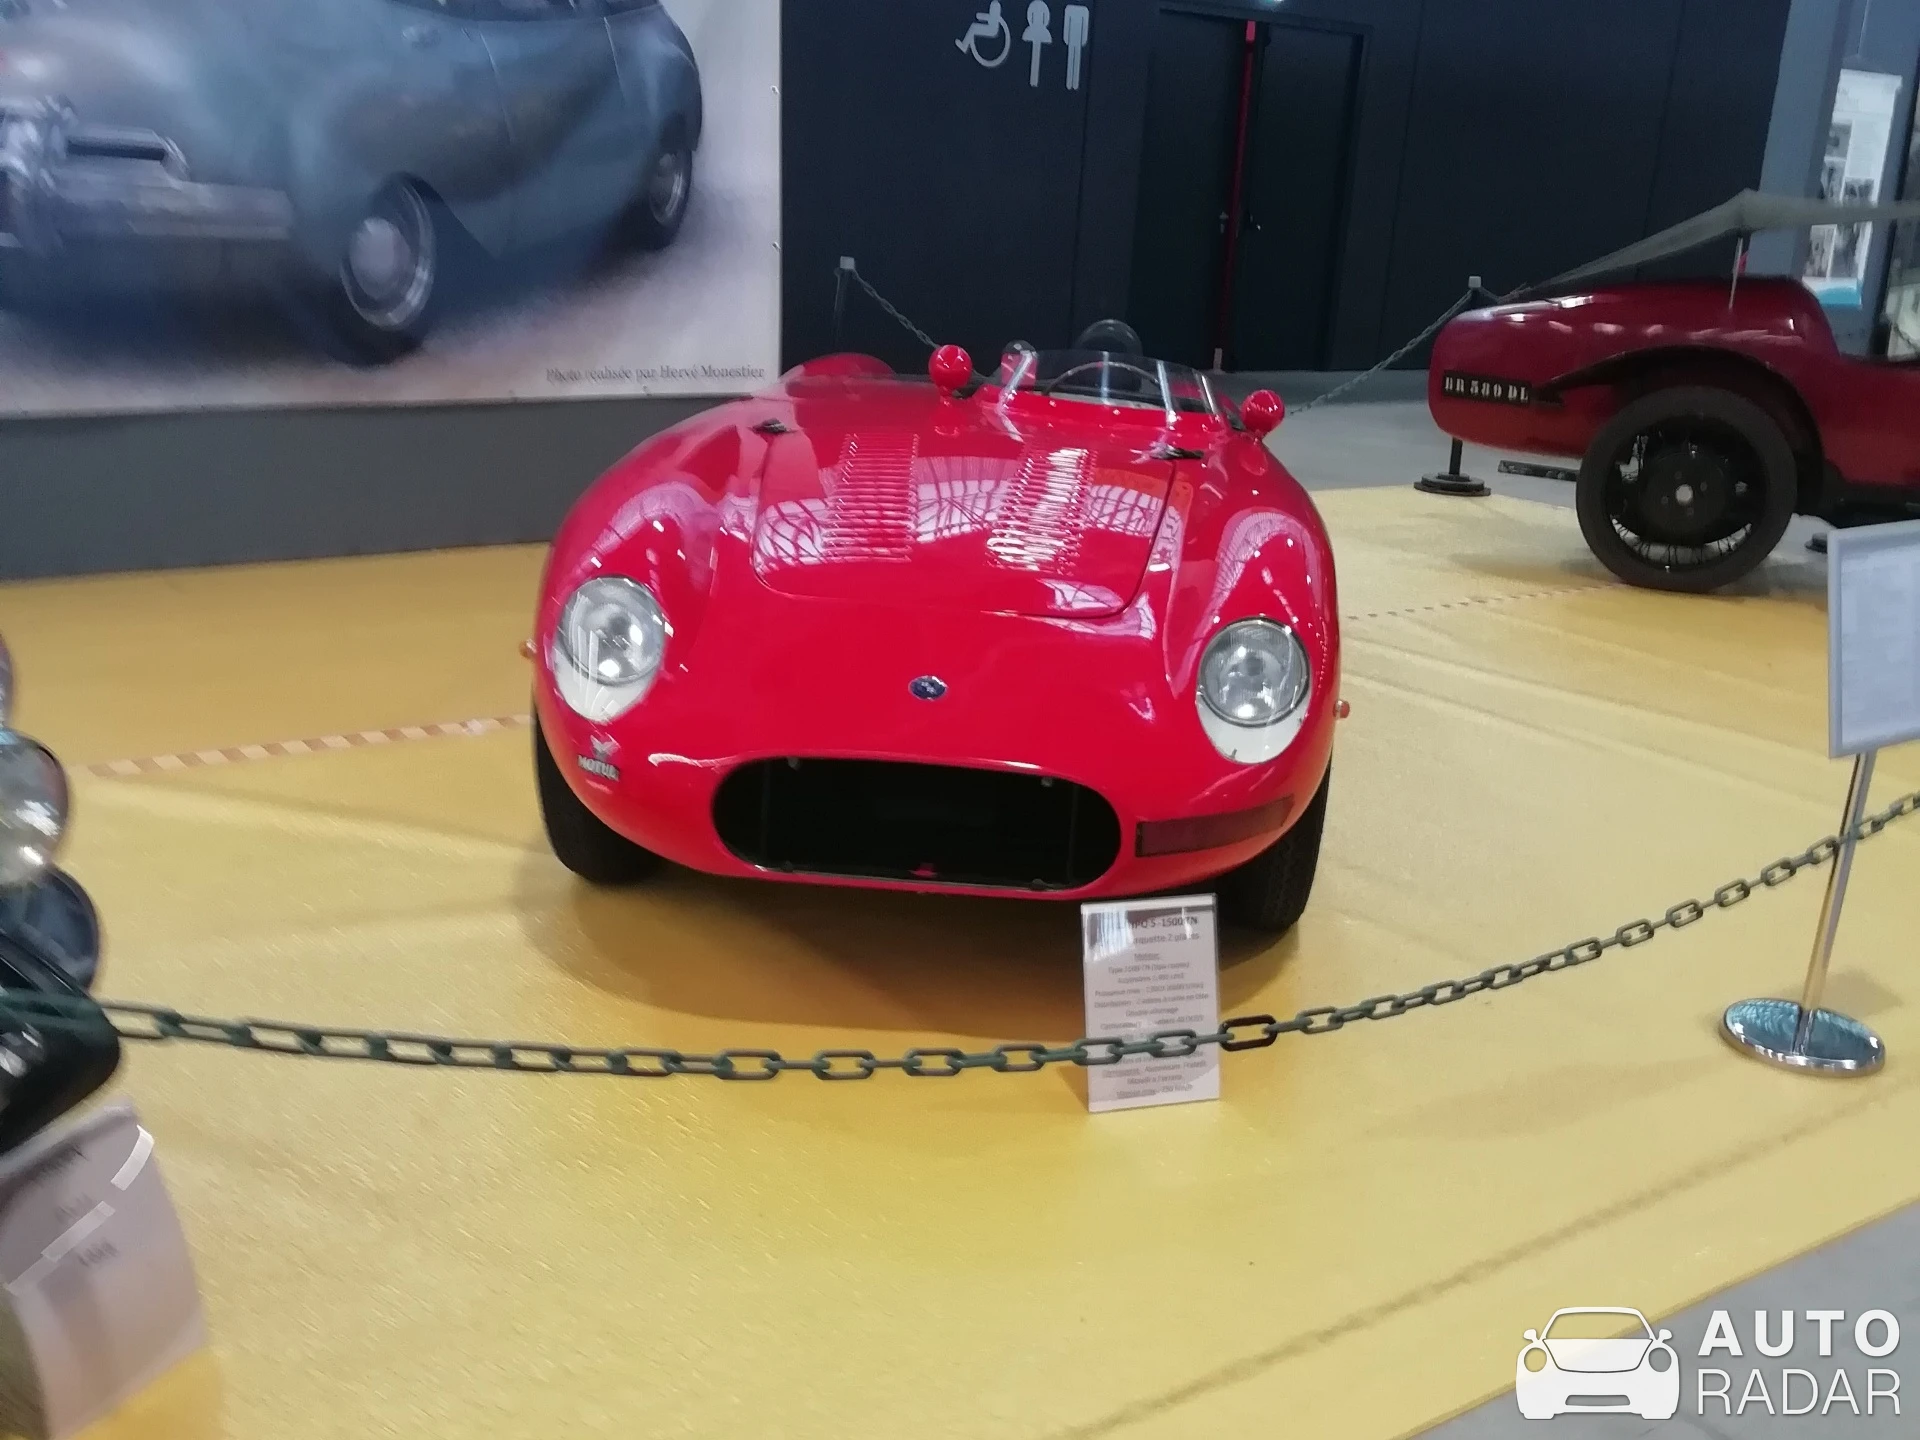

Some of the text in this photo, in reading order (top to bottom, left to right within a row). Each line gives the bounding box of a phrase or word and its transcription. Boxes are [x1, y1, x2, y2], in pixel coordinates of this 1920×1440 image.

[635, 368, 656, 383] par
[659, 364, 698, 380] Hervé
[701, 364, 764, 379] Monestier
